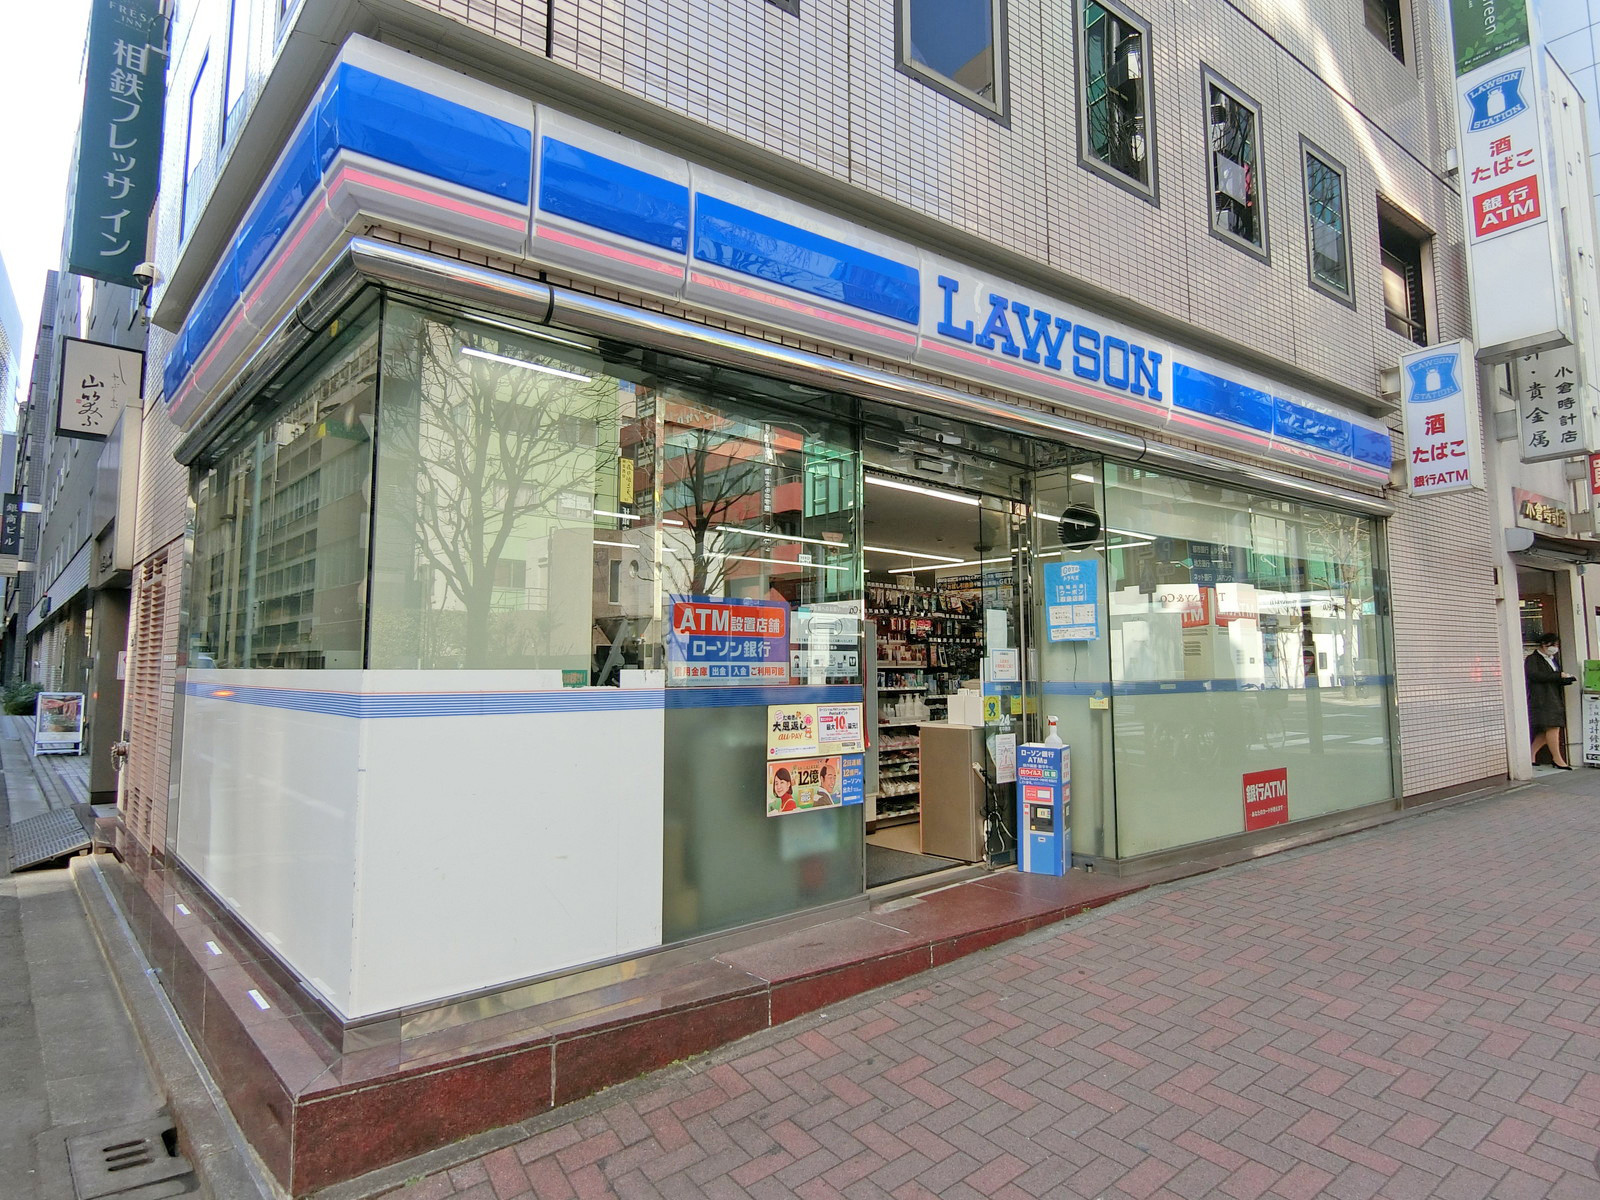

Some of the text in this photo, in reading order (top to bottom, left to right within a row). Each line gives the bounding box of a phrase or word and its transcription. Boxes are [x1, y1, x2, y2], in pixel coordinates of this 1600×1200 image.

[109, 0, 156, 27] FRESA
[121, 16, 142, 29] INN
[1470, 72, 1520, 99] LAWSON
[1473, 104, 1522, 129] STATION
[99, 39, 147, 257] 相鉄フレッサイン
[1490, 135, 1511, 157] 酒
[1471, 149, 1535, 184] たばこ
[1482, 186, 1529, 213] 銀行
[1481, 198, 1534, 229] ATM
[937, 275, 1163, 402] LAWSON
[1411, 356, 1454, 372] LAWSON
[1414, 385, 1455, 400] STATION
[1554, 366, 1578, 444] 小倉時計店
[1425, 413, 1445, 436] 酒
[1412, 440, 1466, 464] たばこ
[1413, 469, 1469, 488] 銀行ATM
[692, 638, 771, 659] ローソン銀行
[711, 667, 727, 677] 出金
[732, 667, 748, 677] 入金
[751, 665, 785, 677] ご利用可能
[772, 720, 807, 732] 大恩返し
[790, 732, 803, 740] PAY
[797, 768, 820, 787] 12億
[1245, 779, 1287, 804] 銀行ATM
